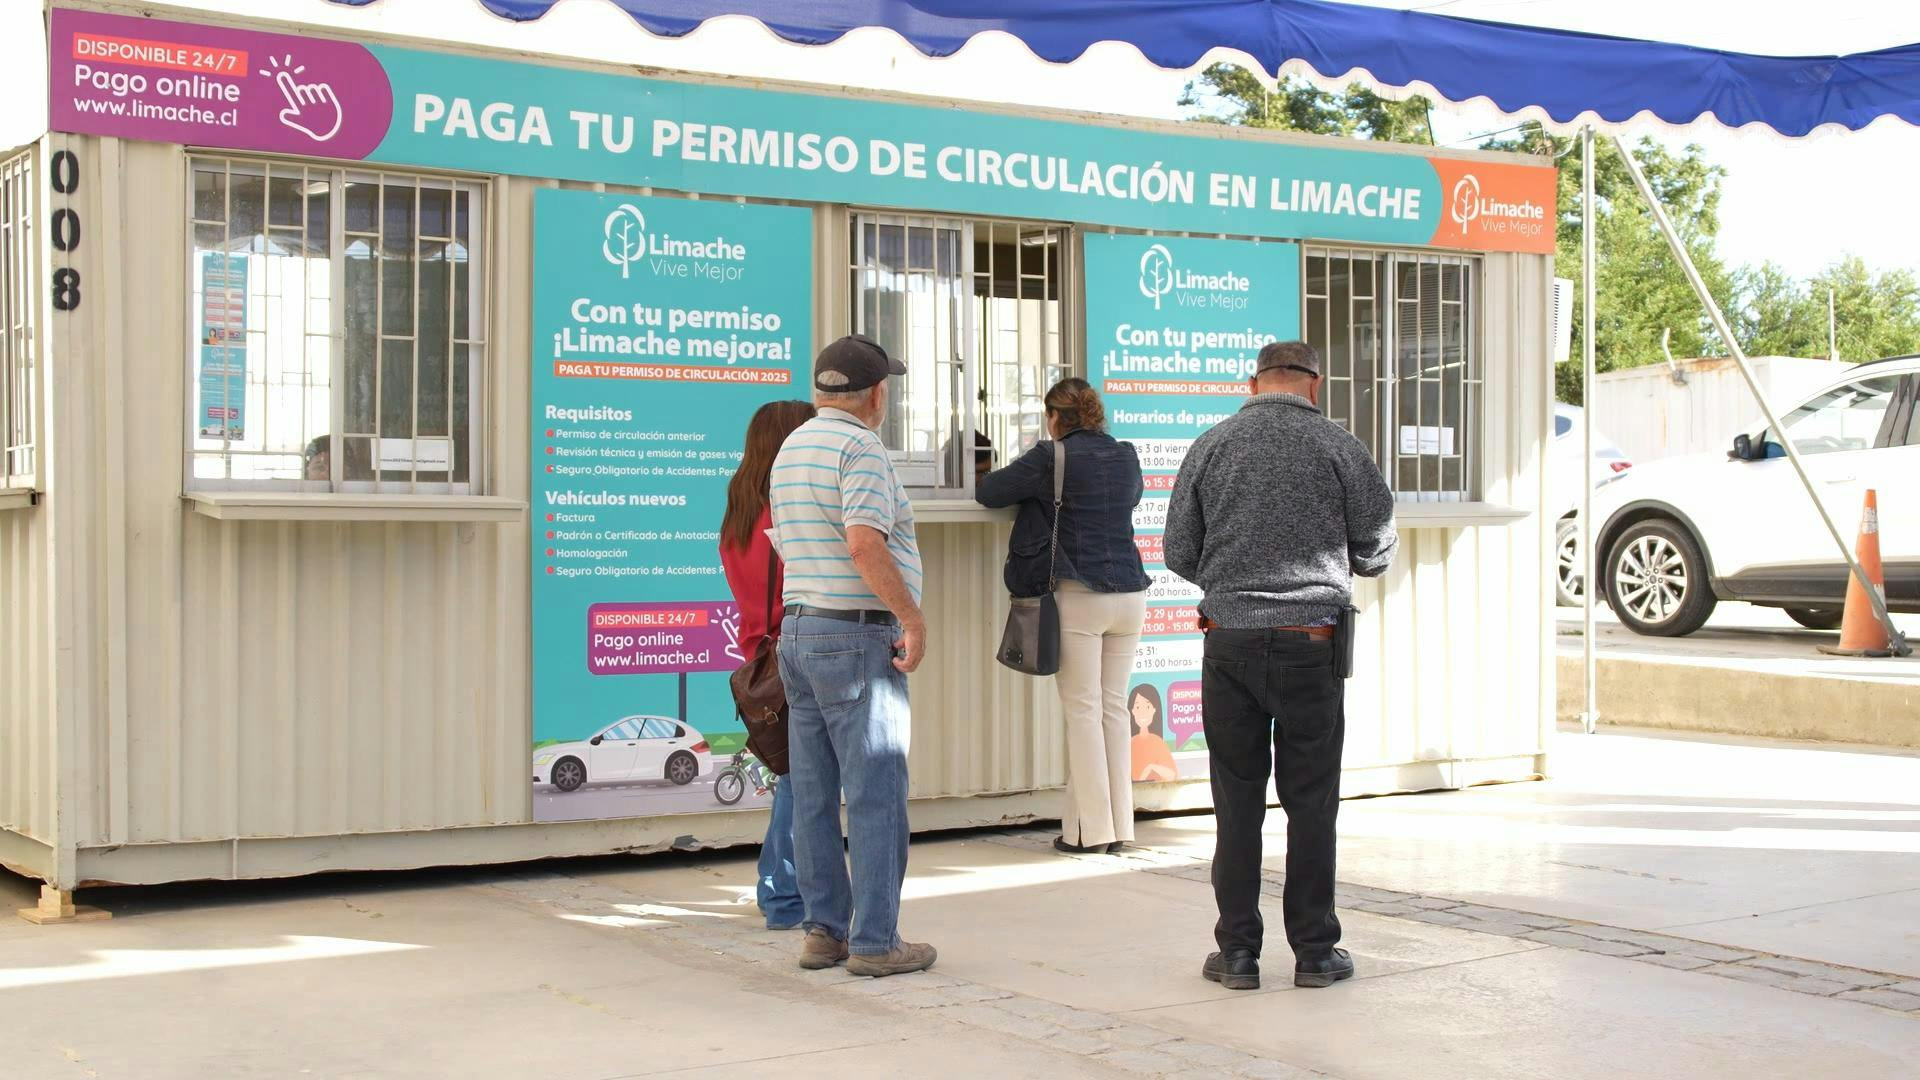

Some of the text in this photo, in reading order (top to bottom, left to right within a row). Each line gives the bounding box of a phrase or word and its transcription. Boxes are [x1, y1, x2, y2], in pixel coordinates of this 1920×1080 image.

[77, 38, 237, 71] DISPONIBLE 24/7
[75, 64, 241, 102] Pago online
[73, 96, 237, 126] www.limache.cl
[413, 93, 1422, 221] PAGA TU PERMISO DE CIRCULACIÓN EN LIMACHE
[1481, 198, 1544, 219] Limache
[1481, 218, 1544, 237] Vive Mejor
[650, 233, 746, 260] Limache
[650, 258, 744, 284] Vive Mejor
[1176, 269, 1250, 291] Limache
[1176, 290, 1249, 312] Vive Mejor
[571, 298, 781, 333] Con tu permiso
[1116, 323, 1159, 346] Con
[1163, 327, 1186, 347] tu
[554, 327, 791, 364] ¡Limache mejora!
[1103, 350, 1201, 376] ¡Limache
[559, 364, 788, 383] PAGA TU PERMISO DE CIRCULACIÓN 2025
[1107, 382, 1132, 392] PAGA
[1134, 383, 1146, 392] TU
[1147, 383, 1187, 393] PERMISO
[1189, 384, 1201, 393] DE
[545, 405, 632, 423] Requisitos
[1113, 409, 1173, 424] Horarios
[1176, 411, 1194, 424] de
[556, 429, 706, 442] Permiso de circulación anterior
[556, 446, 598, 457] Revisión
[600, 447, 636, 458] técnica
[638, 450, 644, 459] y
[646, 447, 681, 459] emisión
[685, 449, 697, 460] de
[699, 451, 727, 461] gases
[1146, 443, 1151, 453] 3
[1153, 443, 1162, 453] al
[556, 465, 592, 477] Seguro
[594, 465, 650, 477] Obligatorio
[652, 466, 664, 476] de
[666, 466, 716, 477] Accidentes
[545, 490, 687, 506] Vehículos nuevos
[1145, 502, 1154, 512] 17
[556, 513, 595, 523] Factura
[1143, 515, 1165, 525] 13:00
[556, 530, 593, 541] Padrón
[595, 533, 601, 541] o
[604, 530, 658, 541] Certificado
[660, 531, 672, 540] de
[556, 548, 628, 560] Homologación
[556, 567, 592, 578] Seguro
[594, 566, 650, 577] Obligatorio
[652, 566, 664, 575] de
[666, 565, 717, 575] Accidentes
[1168, 587, 1192, 596] horas
[596, 612, 696, 626] DISPONIBLE 24/7
[1154, 608, 1165, 618] 29
[594, 631, 683, 650] Pago online
[594, 649, 710, 667] www.limache.cl
[1144, 658, 1166, 668] 13:00
[1168, 657, 1193, 667] horas
[1172, 703, 1195, 715] Pago
